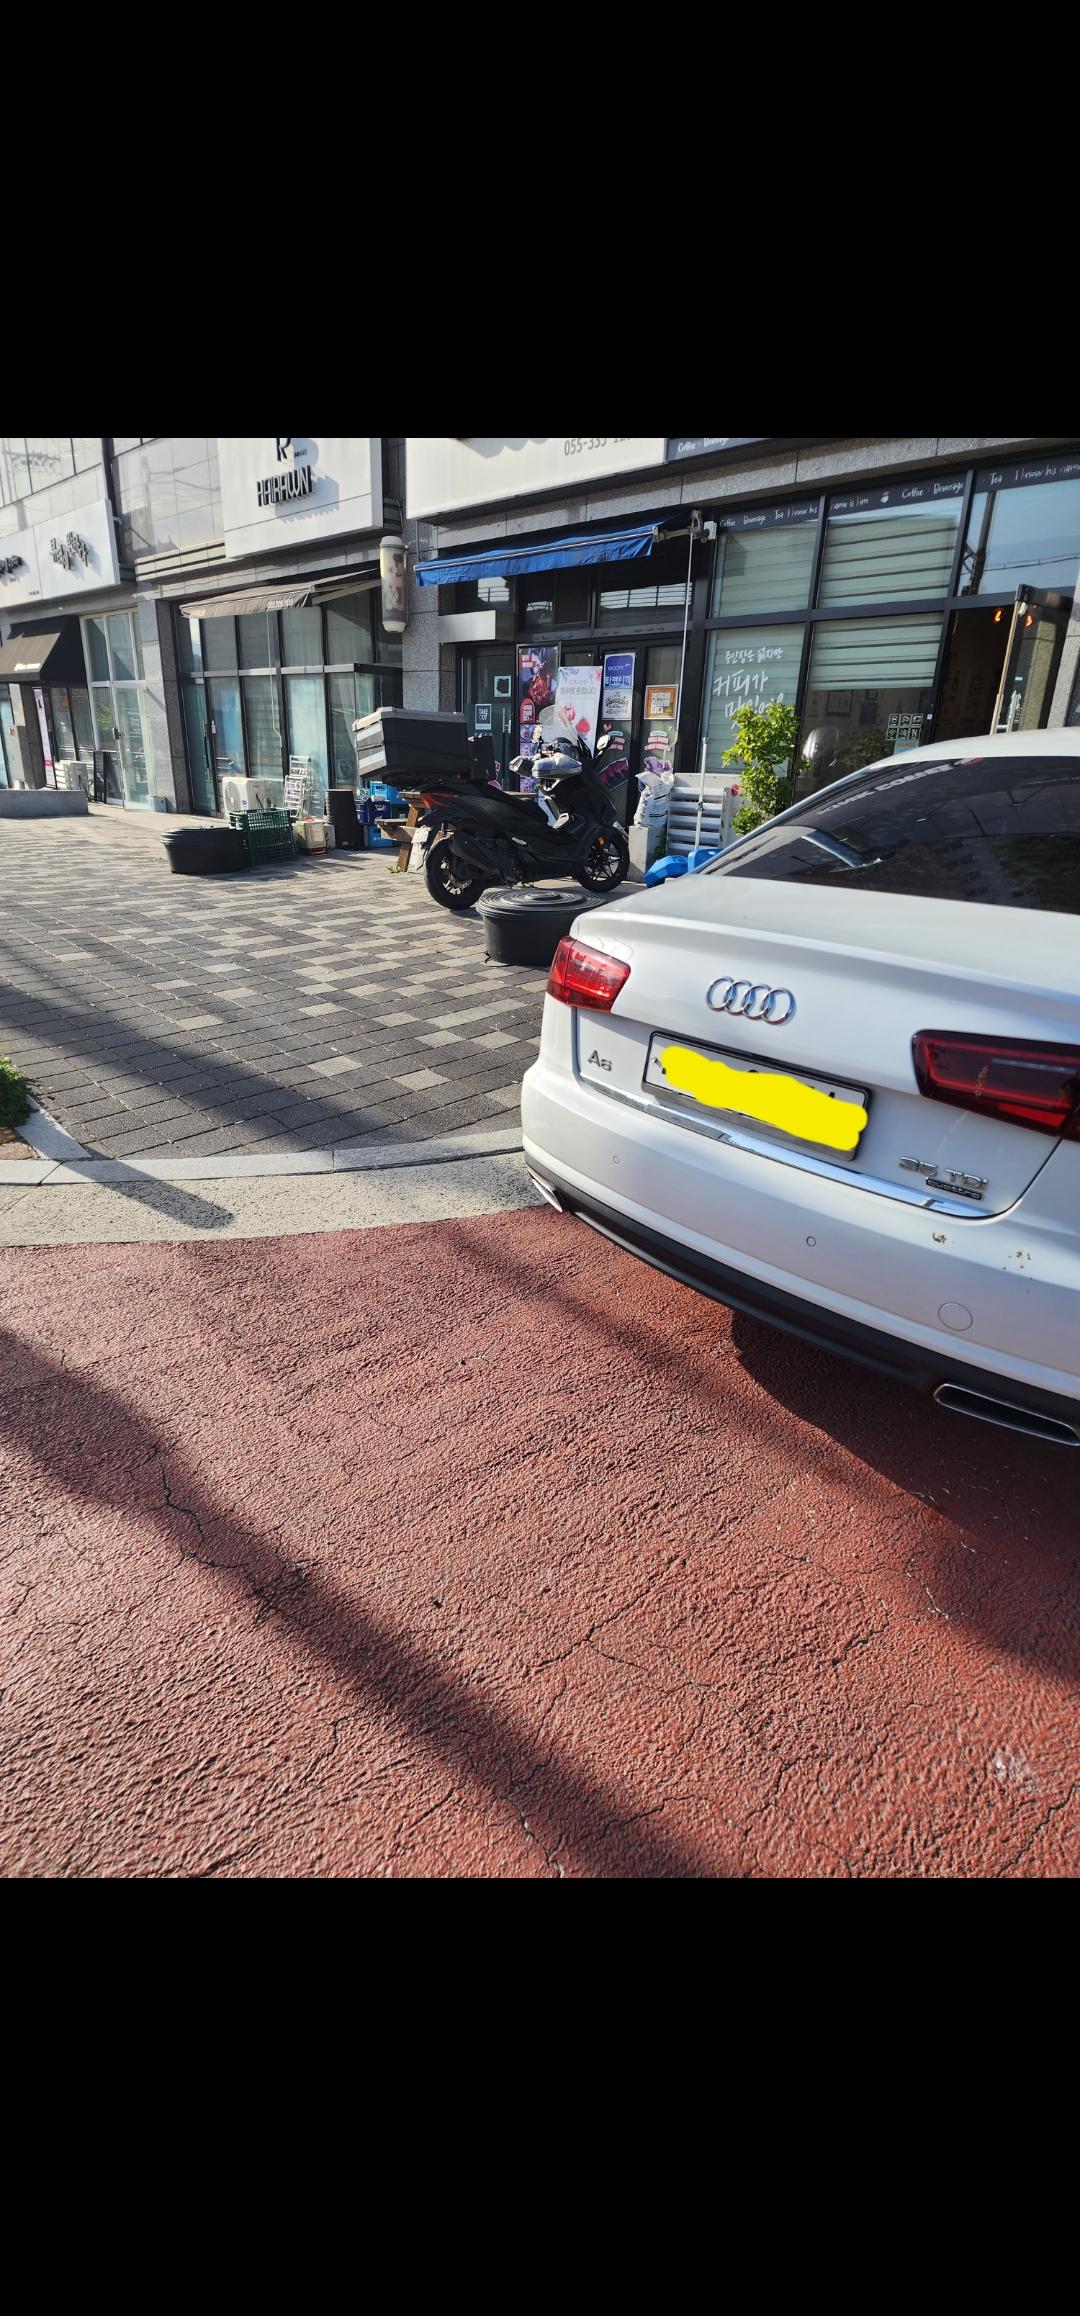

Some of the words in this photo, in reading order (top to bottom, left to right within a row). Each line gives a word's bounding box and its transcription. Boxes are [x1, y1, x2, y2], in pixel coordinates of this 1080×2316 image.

[901, 488, 925, 500] Coffee
[933, 481, 964, 494] Beverage
[989, 472, 1003, 485] Tea
[719, 518, 737, 529] Coffee
[743, 514, 767, 526] Beverage
[713, 668, 769, 697] 커피가
[588, 1049, 613, 1072] A6
[926, 1178, 982, 1200] quattro
[944, 1168, 988, 1191] TDI
